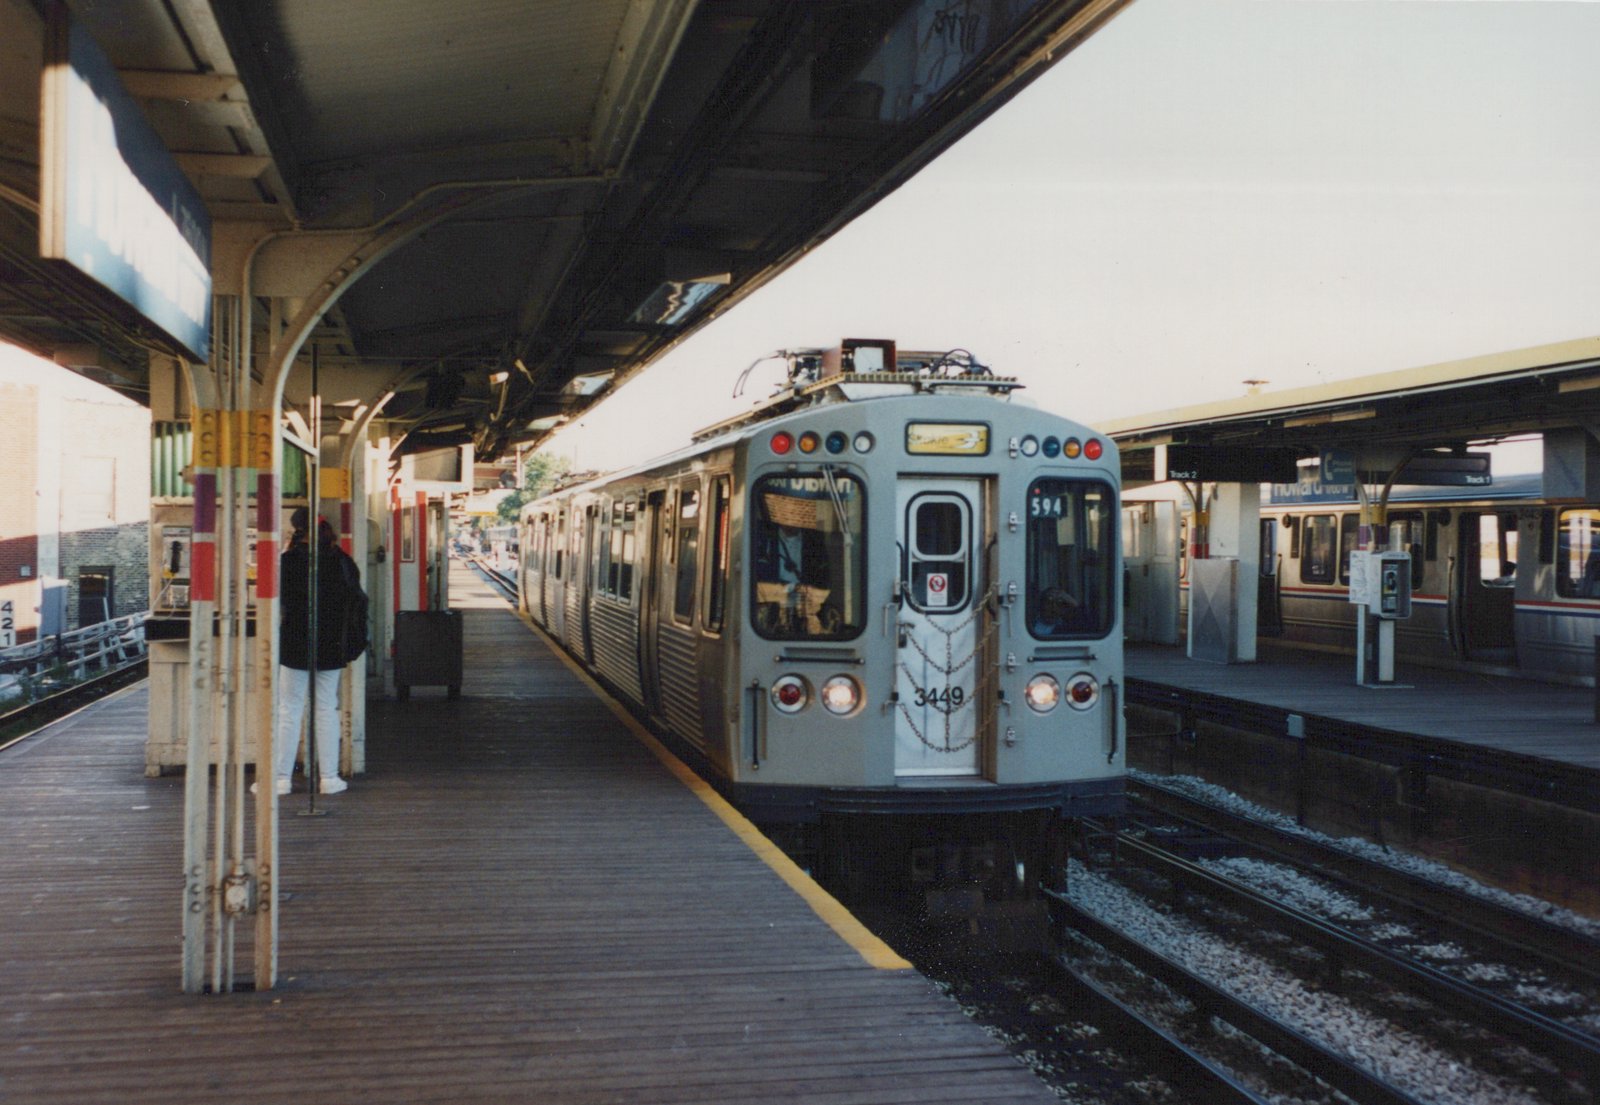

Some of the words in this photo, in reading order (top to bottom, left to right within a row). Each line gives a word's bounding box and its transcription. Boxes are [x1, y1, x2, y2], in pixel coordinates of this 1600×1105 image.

[1169, 470, 1190, 479] Track
[1190, 470, 1198, 479] 2
[1465, 475, 1485, 484] Track
[1485, 475, 1491, 484] 1
[1031, 497, 1062, 516] 594
[1, 600, 14, 646] 421
[914, 686, 964, 707] 3449
